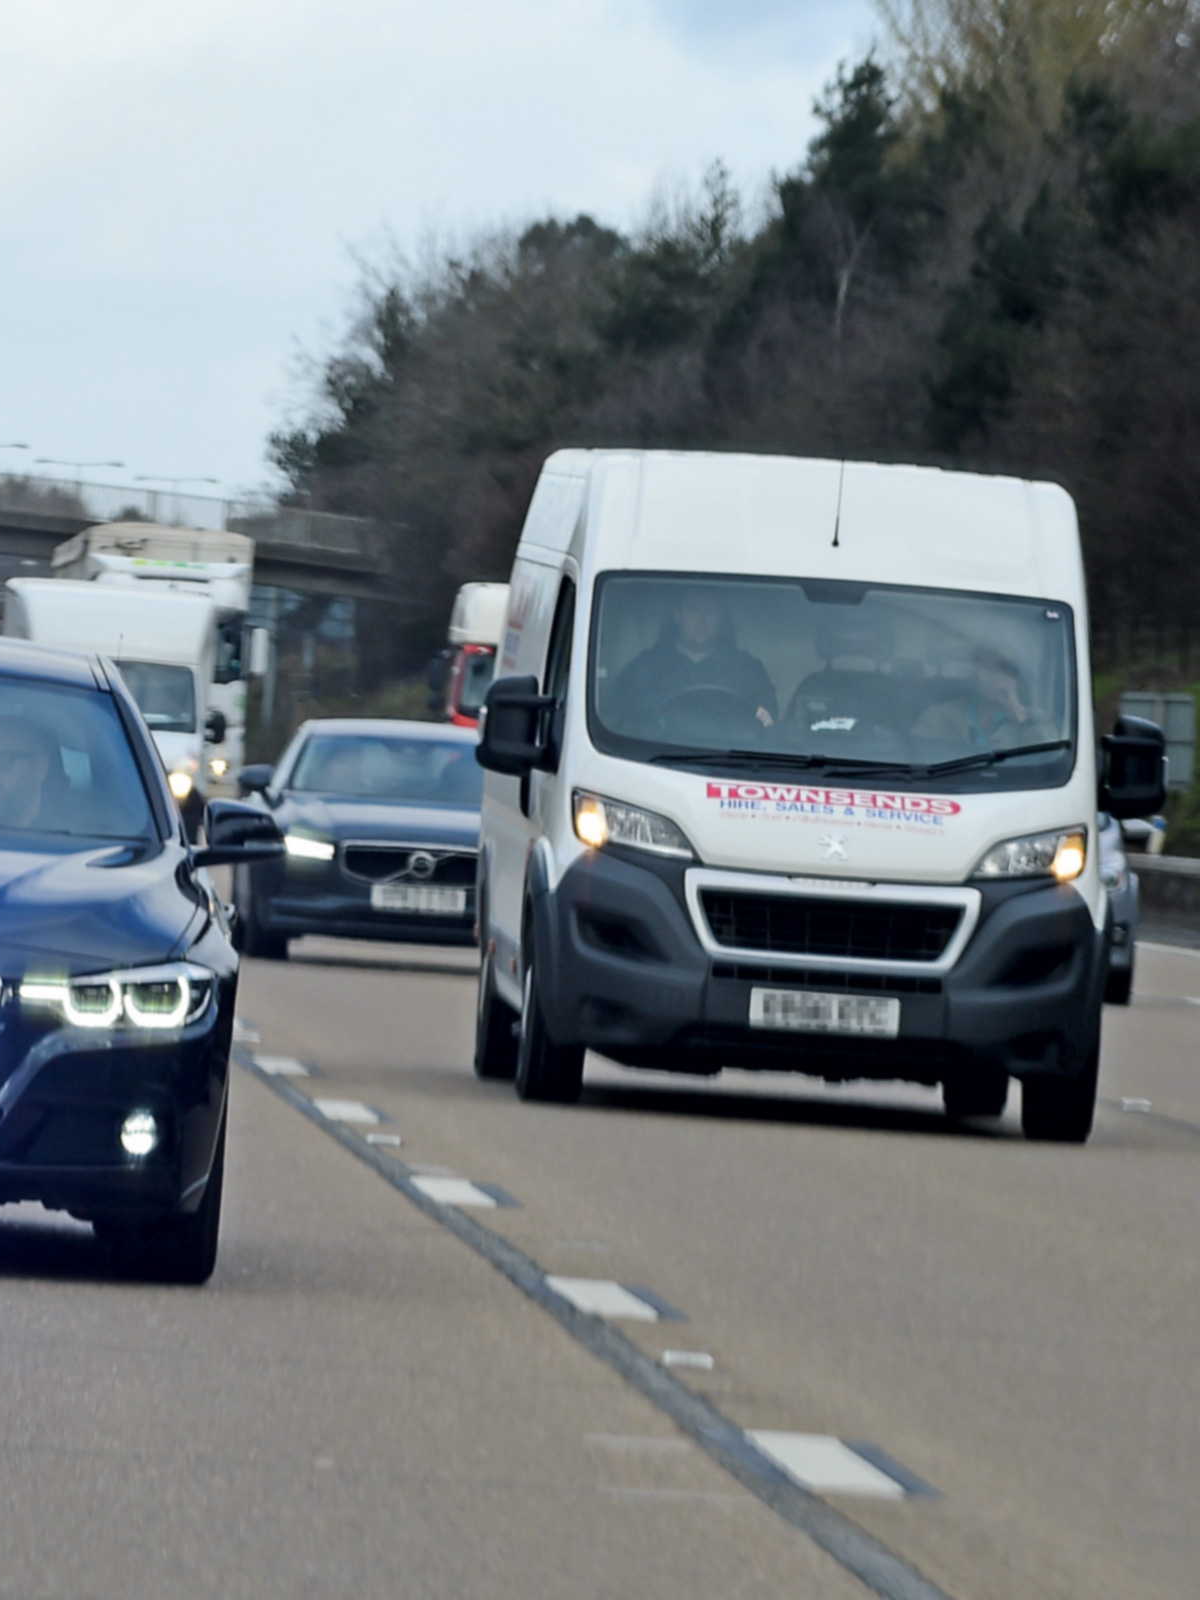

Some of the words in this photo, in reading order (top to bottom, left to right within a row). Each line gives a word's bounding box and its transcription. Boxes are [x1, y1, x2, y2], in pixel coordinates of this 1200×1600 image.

[711, 784, 956, 815] TOWNSENDS
[776, 801, 834, 815] SALES
[844, 806, 855, 816] &
[866, 808, 944, 826] SERVICE
